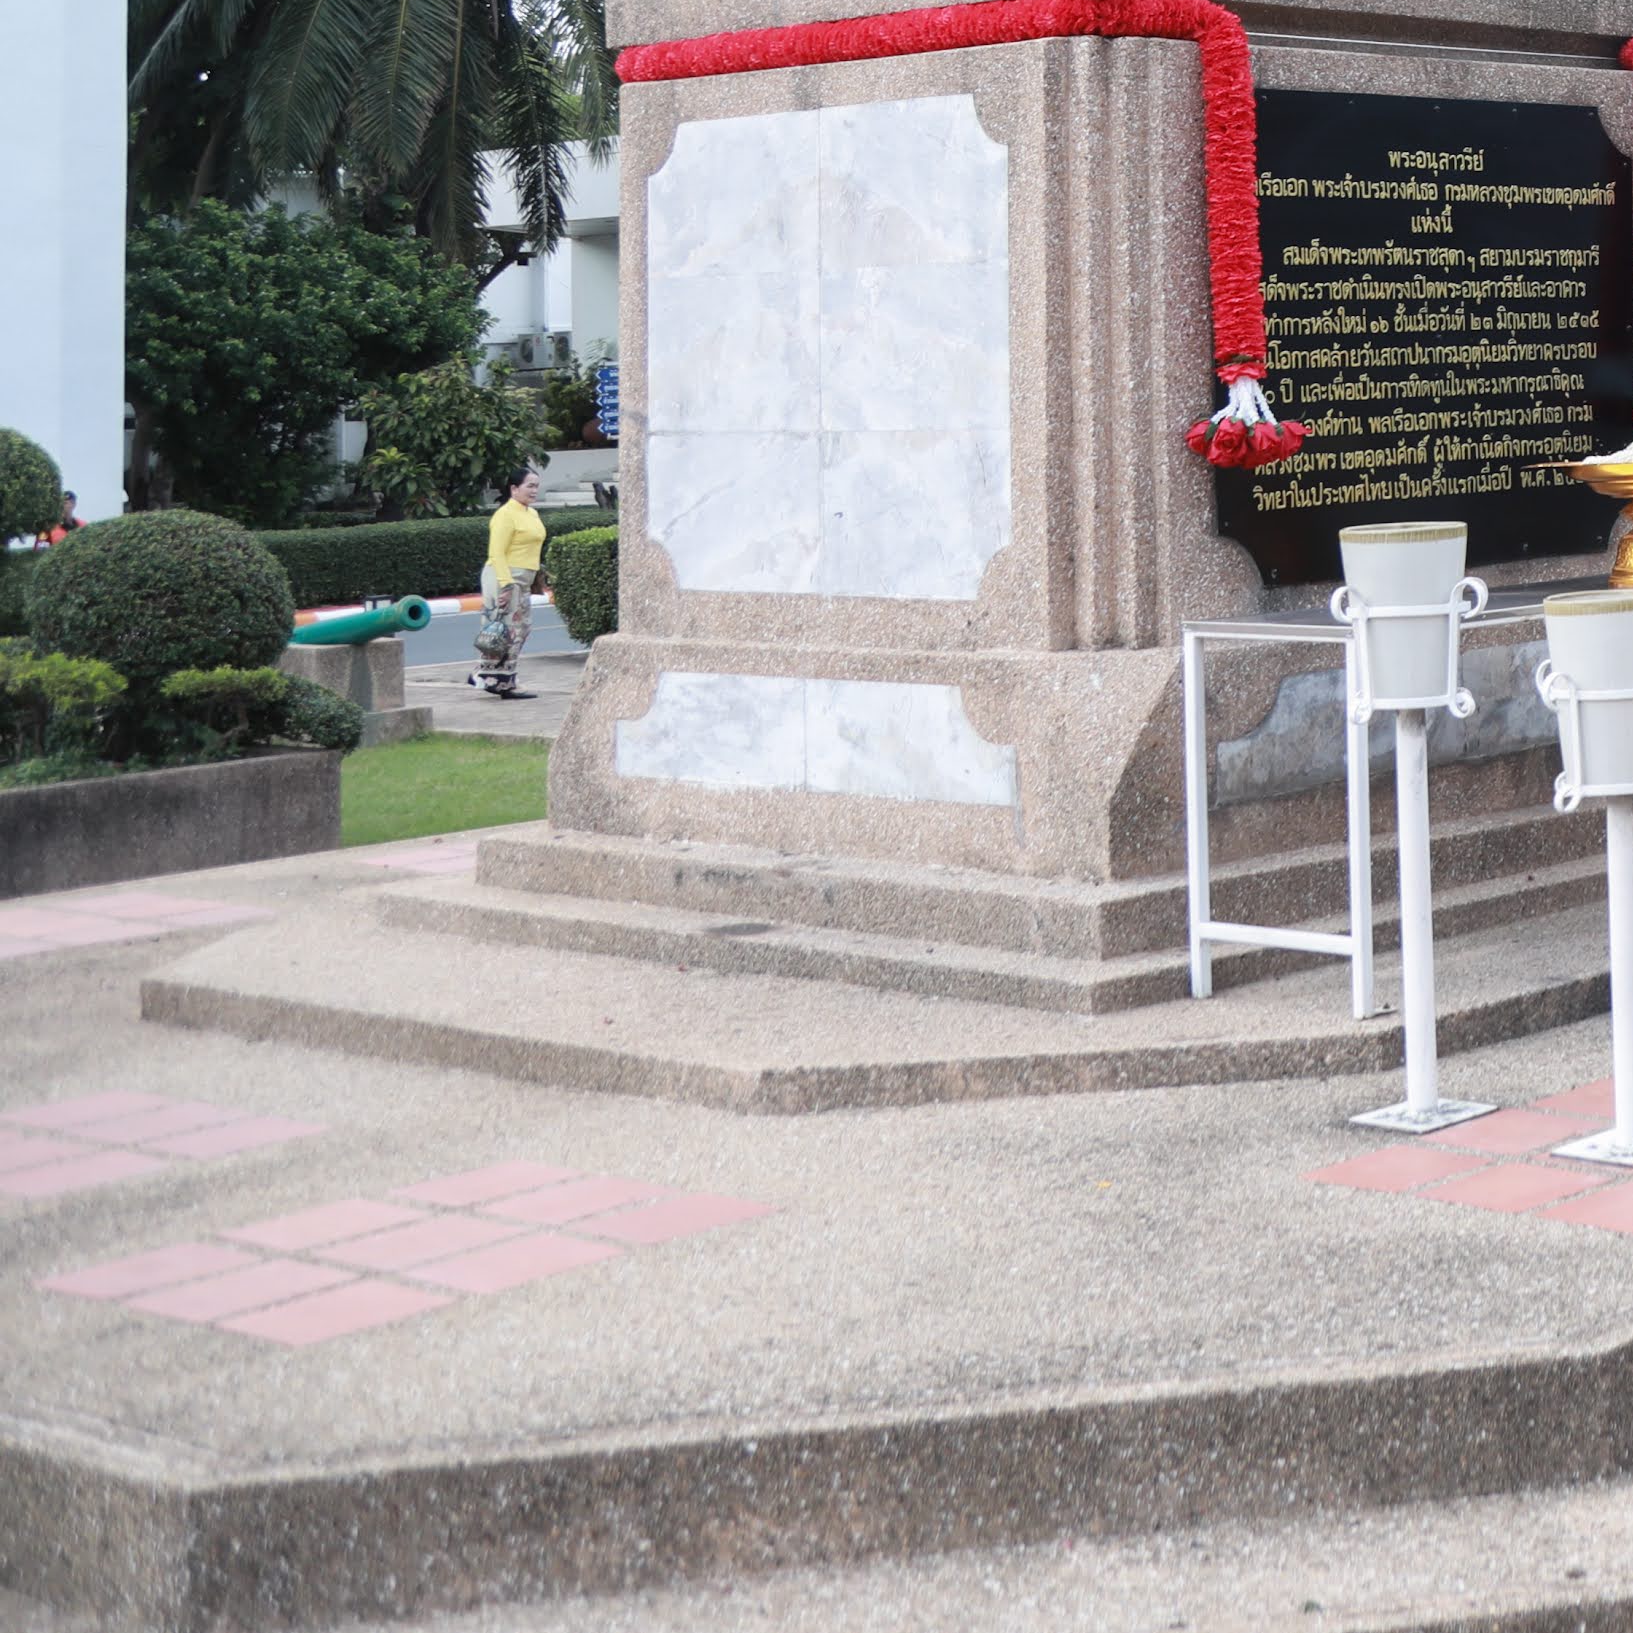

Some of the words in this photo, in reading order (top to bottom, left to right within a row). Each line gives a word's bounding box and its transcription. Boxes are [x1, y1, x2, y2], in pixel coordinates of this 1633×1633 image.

[1388, 147, 1484, 177] พระอนุสาวรีย์
[1254, 172, 1308, 197] เรือเอก
[1312, 173, 1438, 201] พระเจ้าบรมวงศ์เธอ
[1445, 181, 1617, 210] กรมหลวงชุมพรเขตอุดมศักดิ์
[1411, 204, 1453, 233] แห่งนี้
[1480, 244, 1600, 273] สยามบรมราชกุมารี
[1280, 378, 1295, 404] ปี
